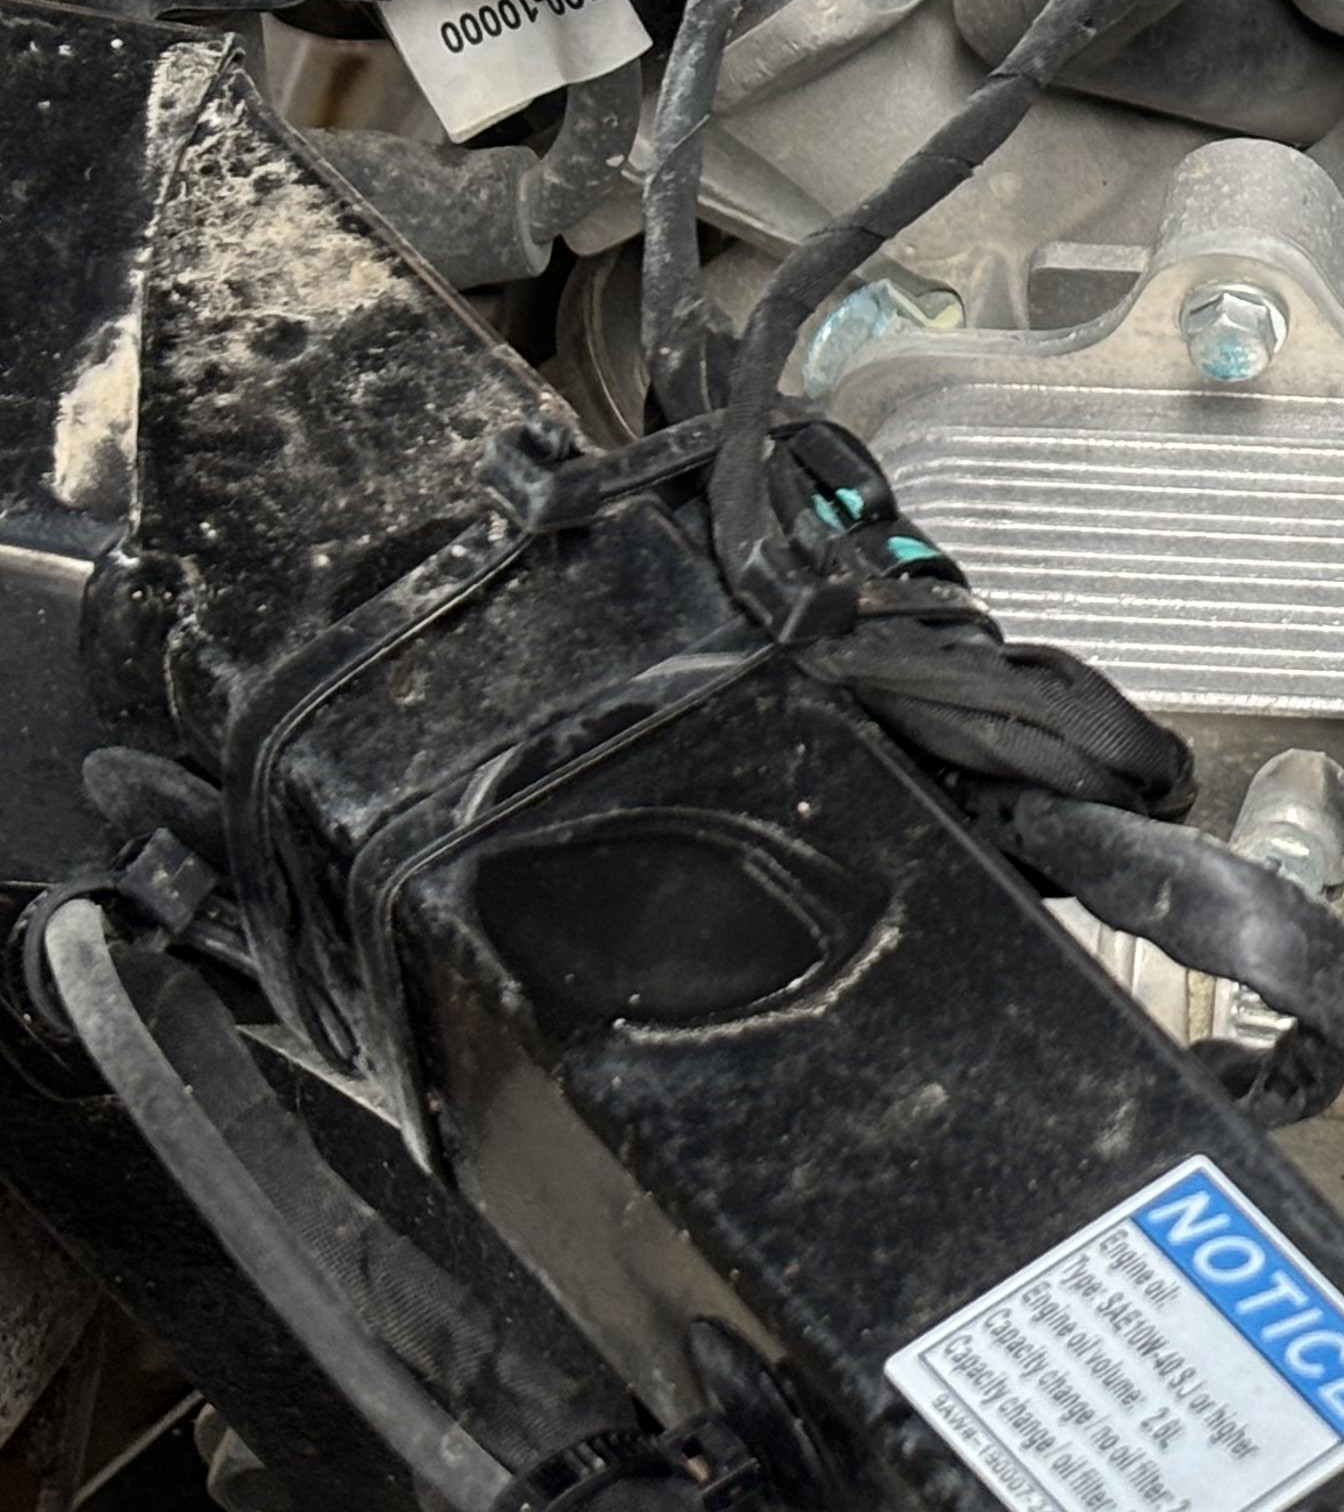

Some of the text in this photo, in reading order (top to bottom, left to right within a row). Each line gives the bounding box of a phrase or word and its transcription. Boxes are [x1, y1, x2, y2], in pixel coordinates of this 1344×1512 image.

[1021, 1280, 1083, 1337] Engine
[1098, 1228, 1182, 1310] Engine oil:
[1059, 1253, 1113, 1303] Type:
[1186, 1391, 1216, 1415] or
[1202, 1402, 1259, 1460] higher
[1066, 1326, 1104, 1356] oil
[1084, 1348, 1148, 1411] volume:
[944, 1332, 1016, 1405] Capacity
[997, 1392, 1056, 1453] change
[1051, 1450, 1088, 1479] oil
[983, 1306, 1055, 1379] Capacity
[1037, 1366, 1095, 1426] change
[1089, 1424, 1121, 1452] no
[1108, 1440, 1146, 1471] oil
